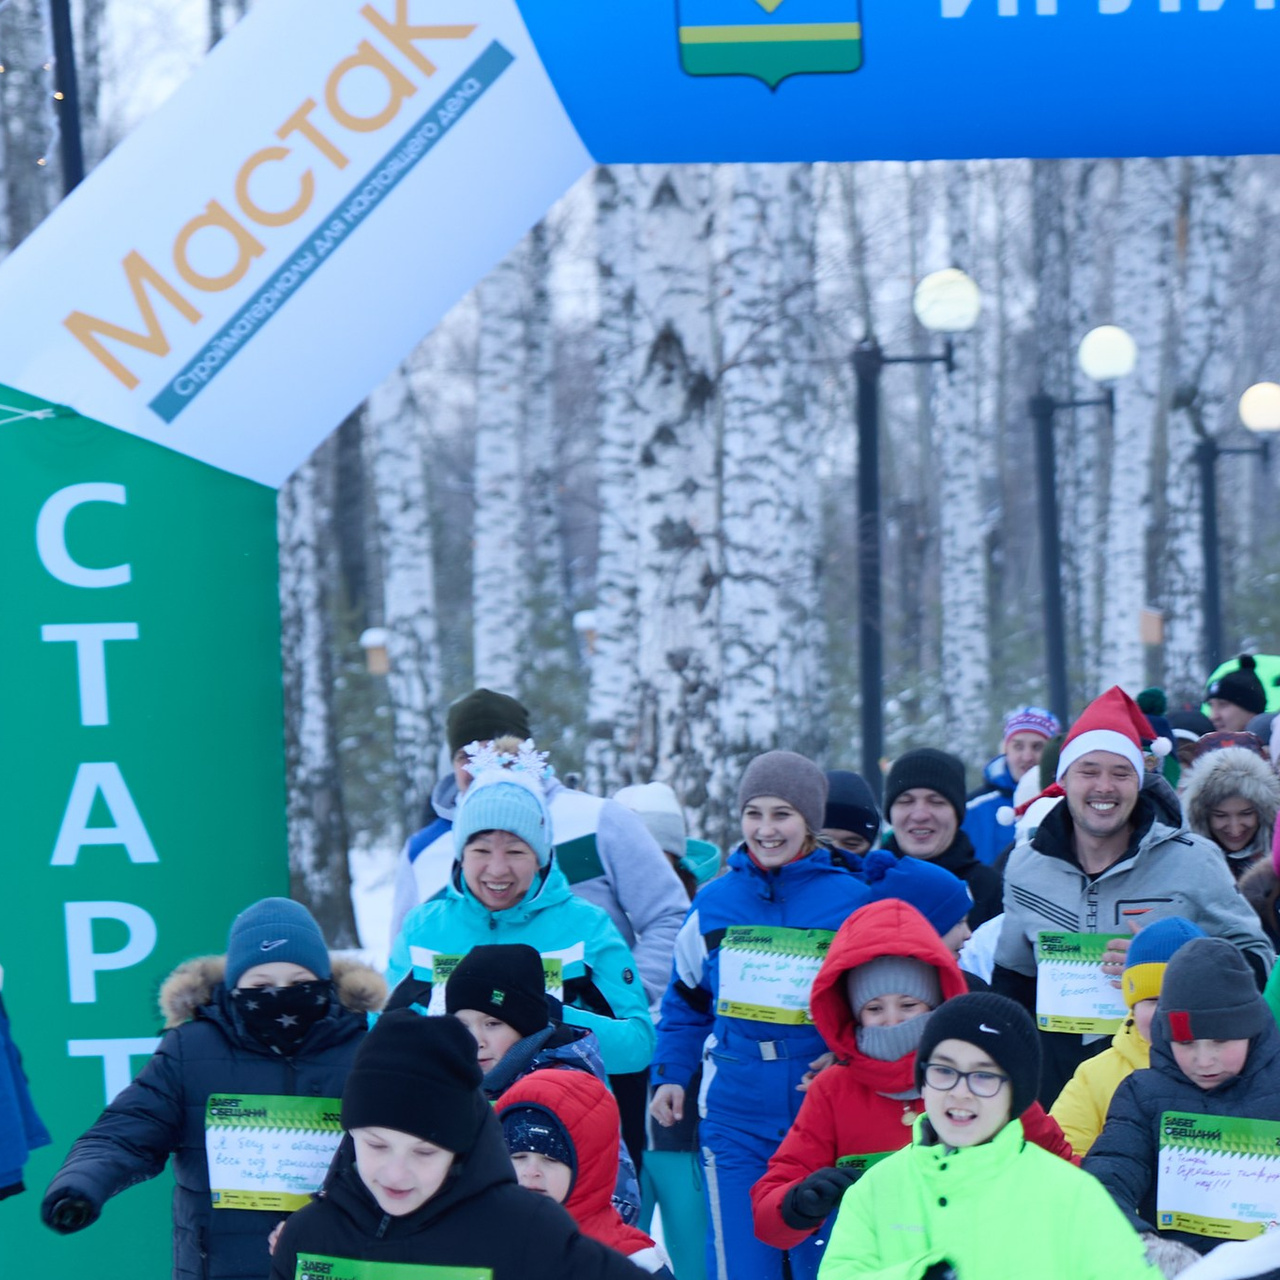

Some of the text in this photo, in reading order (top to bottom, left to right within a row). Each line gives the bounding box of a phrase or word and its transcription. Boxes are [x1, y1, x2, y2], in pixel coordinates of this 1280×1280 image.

[61, 0, 478, 391] Мастак
[173, 76, 483, 397] Стройматериалы для настоящего дела
[35, 481, 163, 1106] СТАРТ
[1164, 1116, 1197, 1127] ЗАБЕГ
[1165, 1127, 1221, 1141] ОБЕЩАНИЙ
[301, 1260, 334, 1274] ЗАБЕГ
